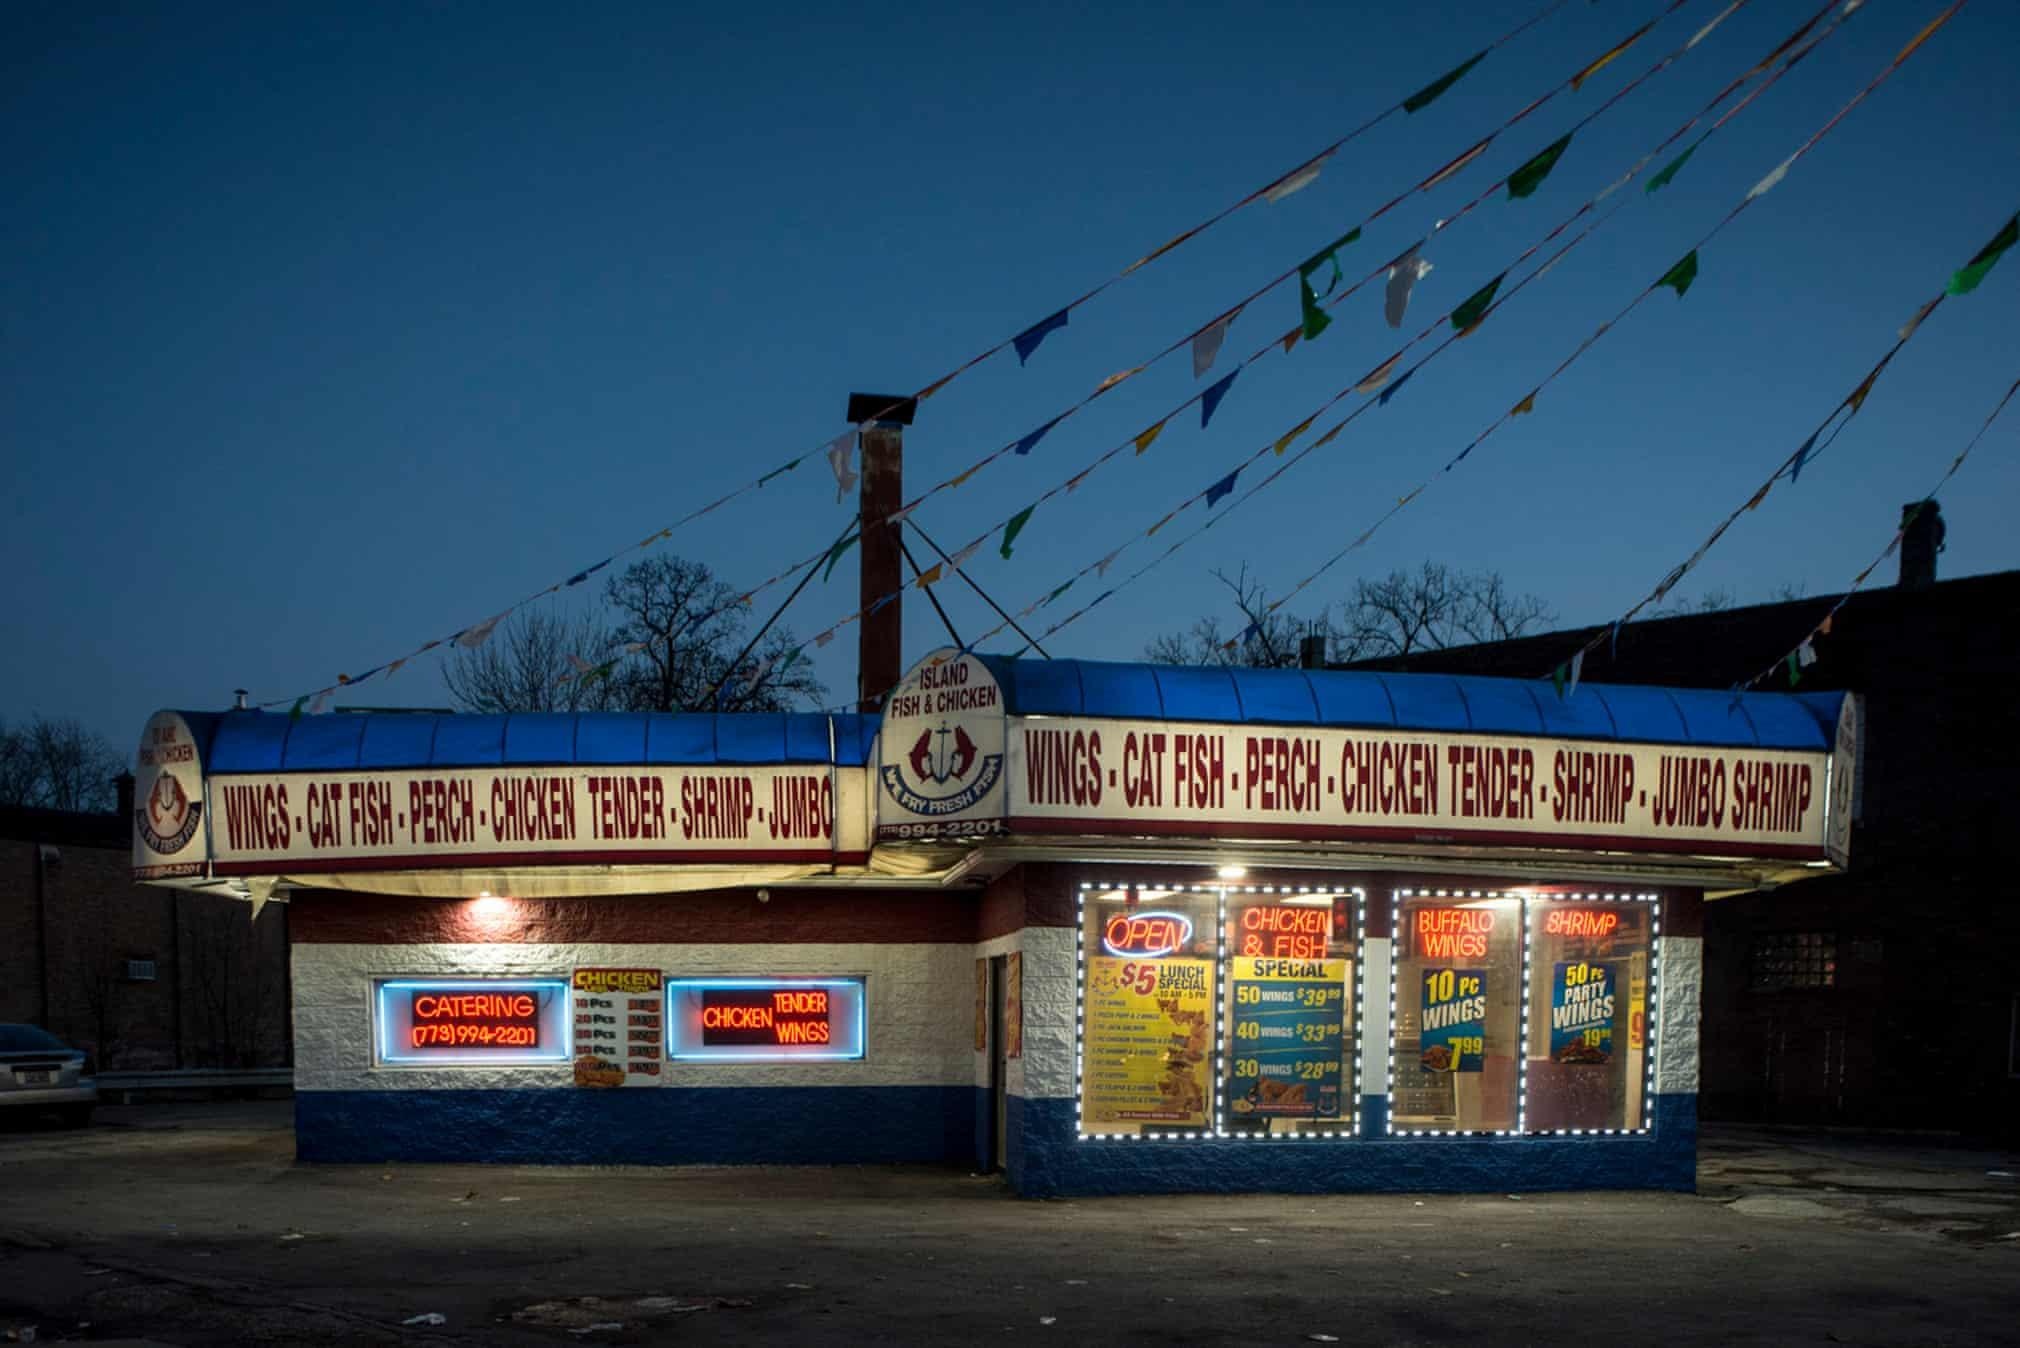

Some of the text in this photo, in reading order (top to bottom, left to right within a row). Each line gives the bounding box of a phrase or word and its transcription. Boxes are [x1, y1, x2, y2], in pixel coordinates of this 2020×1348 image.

[920, 662, 968, 691] ISLAND
[891, 685, 996, 719] FISH & CHICKEN
[1025, 729, 1811, 833] WINGS CAT FISH PERCH CHICKEN TENDER SHRIMP JUMBO SHRIMP
[223, 783, 291, 850] WINGS
[307, 783, 343, 848] CAT
[350, 781, 393, 846] FISH
[409, 779, 475, 844] PERCH
[491, 776, 576, 841] CHICKEN
[588, 776, 666, 839] TENDER
[681, 776, 753, 839] SHRIMP
[769, 776, 833, 839] JUMBO
[929, 790, 974, 813] FRESH
[1243, 907, 1333, 933] CHICKEN
[1419, 910, 1495, 933] BUFFALO
[1547, 911, 1617, 936] SHRIMP
[1107, 918, 1186, 952] OPEN
[1425, 933, 1486, 958] WINGS
[1243, 934, 1328, 960] & FISH
[576, 971, 658, 985] CHICKEN
[1120, 962, 1156, 995] $5
[1160, 965, 1205, 978] LUNCH
[1254, 959, 1328, 977] SPECIAL
[1566, 963, 1605, 986] 50 PC
[1159, 978, 1208, 990] SPECIAL
[1237, 985, 1261, 1004] 50
[1262, 991, 1295, 1002] WINGS
[1425, 969, 1480, 1005] 10 PC
[1565, 981, 1607, 1004] PARTY
[415, 994, 535, 1017] CATERING
[773, 993, 827, 1013] TENDER
[1423, 996, 1486, 1032] WINGS
[1553, 994, 1615, 1030] WINGS
[704, 1007, 772, 1028] CHICKEN
[776, 1022, 829, 1043] WINGS
[1237, 1022, 1260, 1039] 40
[1262, 1027, 1293, 1038] WINGS
[1235, 1059, 1259, 1077] 30
[1260, 1064, 1292, 1075] WINGS
